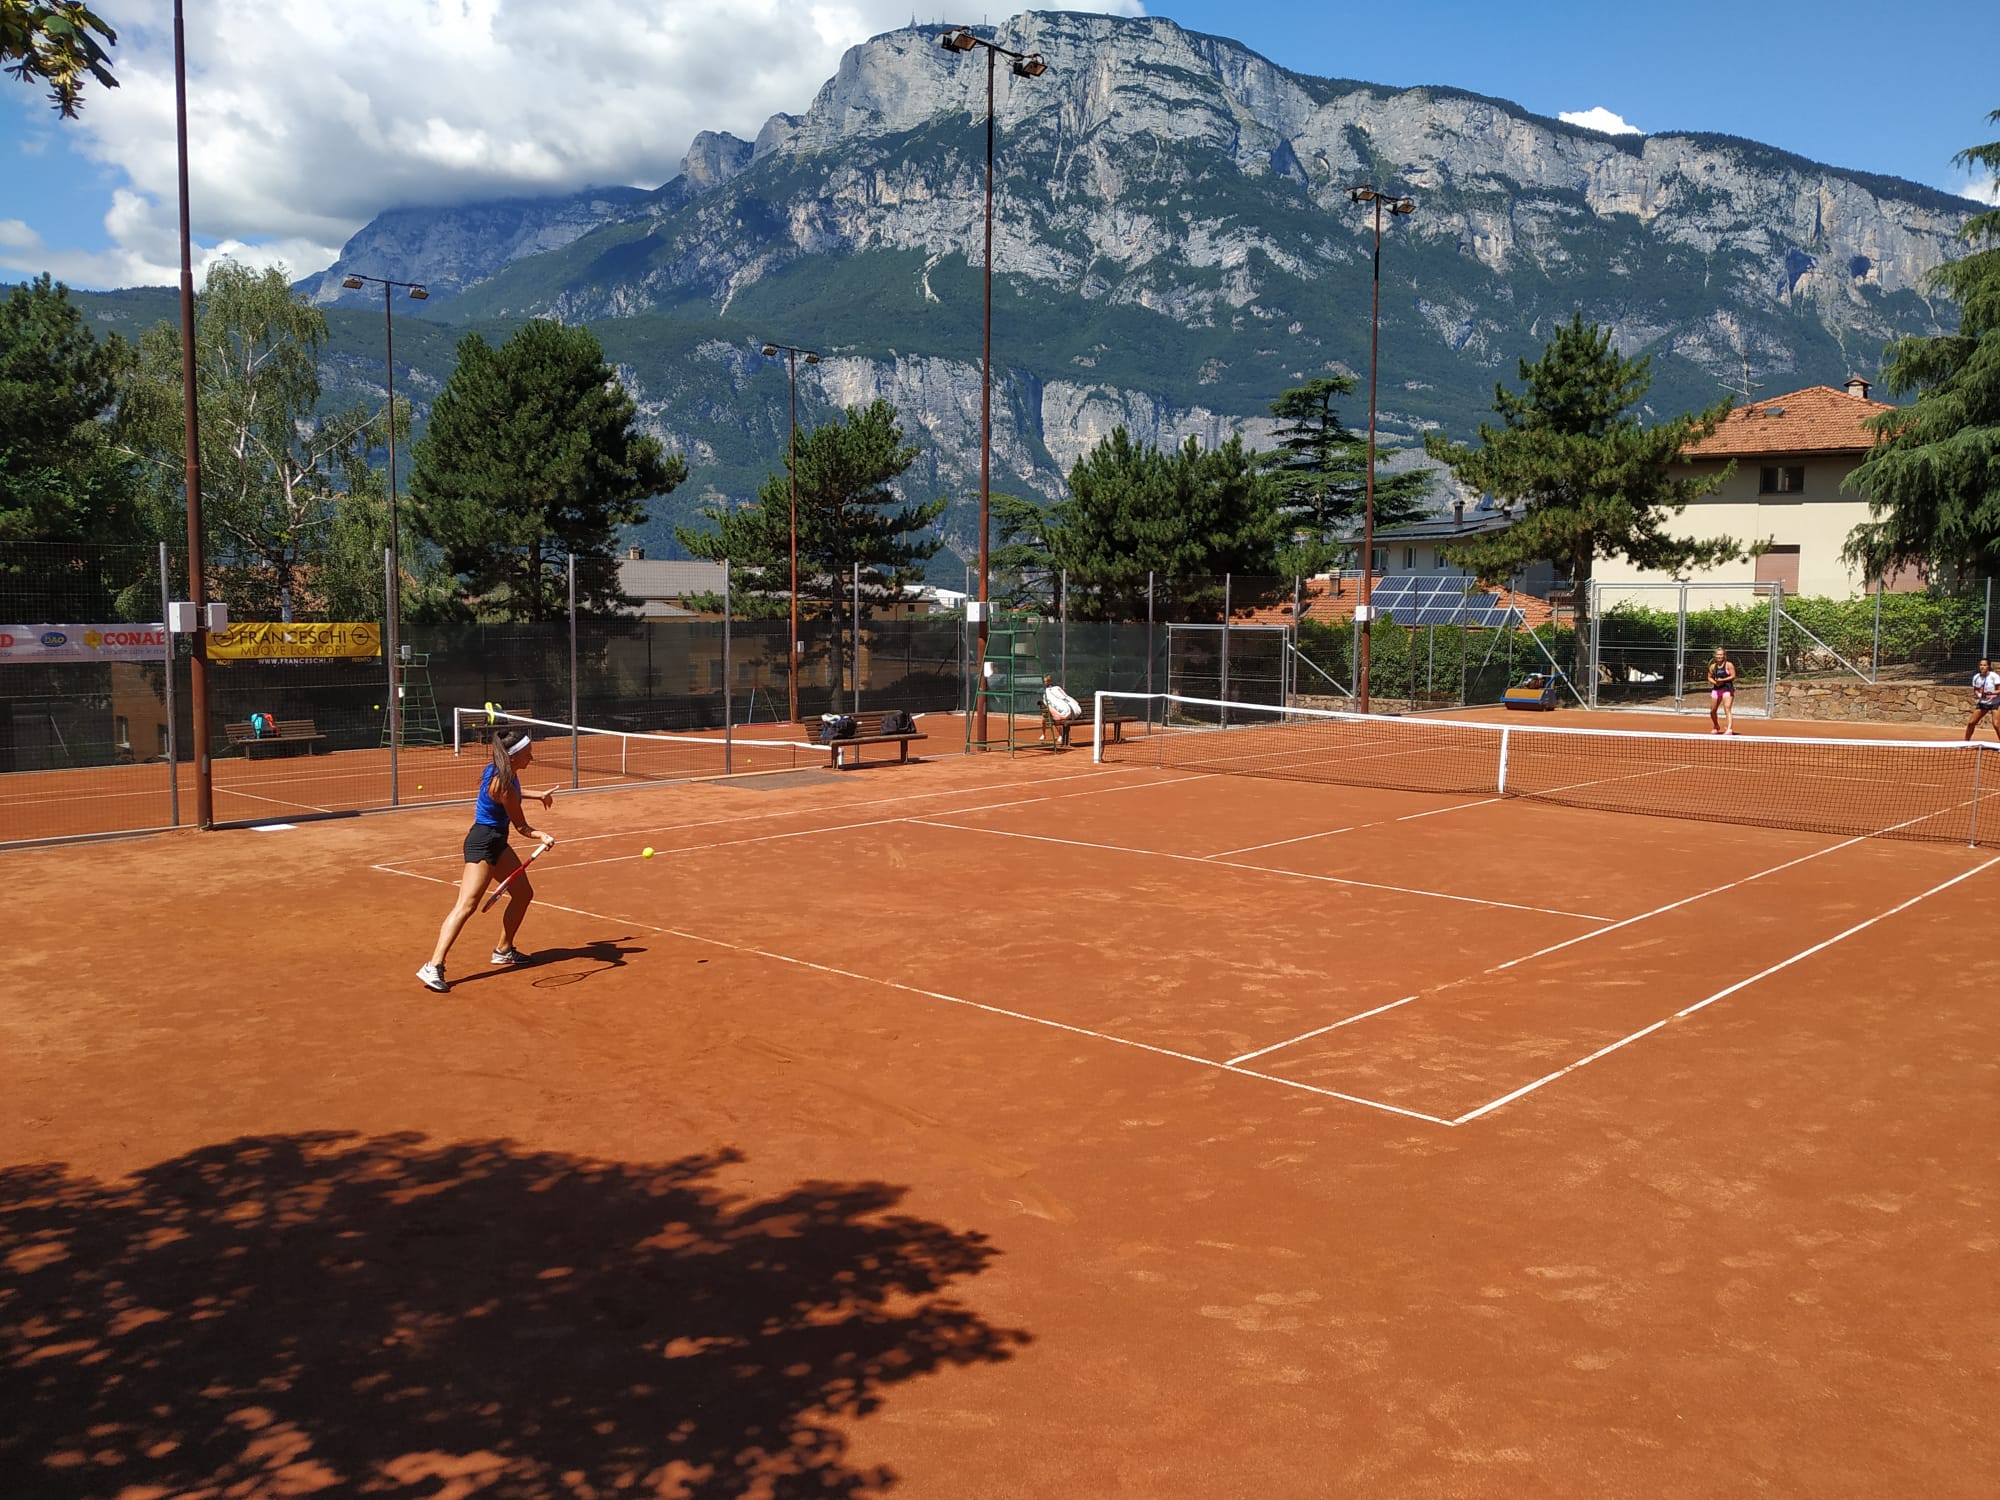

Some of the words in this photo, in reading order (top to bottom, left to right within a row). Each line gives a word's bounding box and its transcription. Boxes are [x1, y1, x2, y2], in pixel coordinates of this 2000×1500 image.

[239, 630, 347, 645] FRANCESCHI
[241, 646, 286, 656] MUOVE
[290, 645, 307, 655] LO
[311, 645, 347, 655] SPORT
